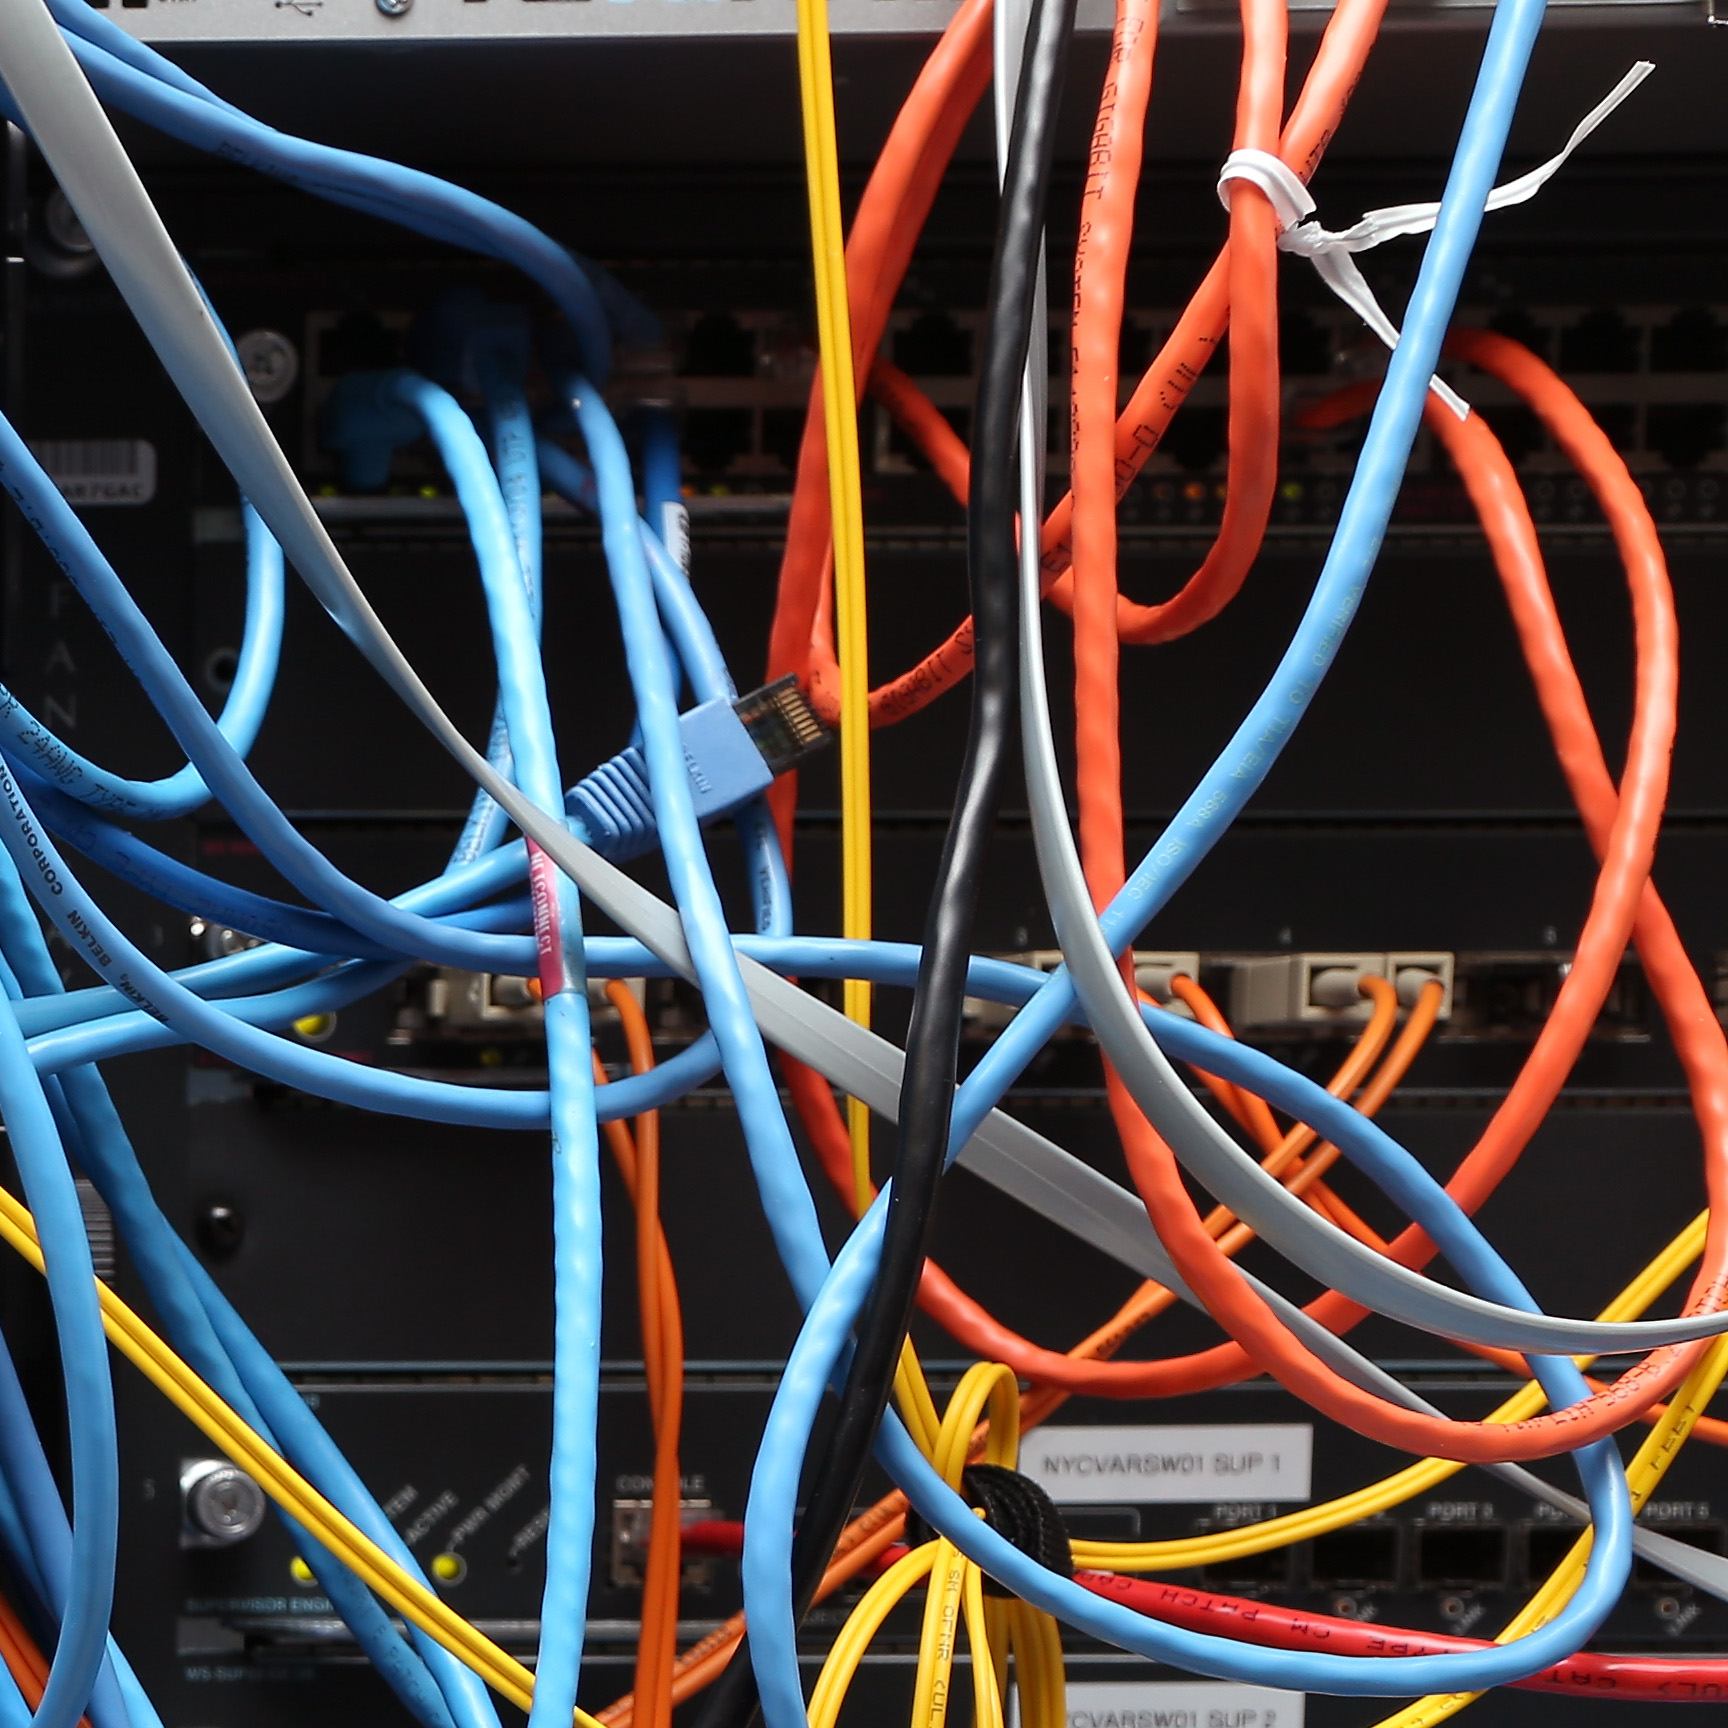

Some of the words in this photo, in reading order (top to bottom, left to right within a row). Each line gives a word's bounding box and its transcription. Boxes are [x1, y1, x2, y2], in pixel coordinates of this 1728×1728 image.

[67, 908, 113, 969] BELKIN
[1042, 1454, 1202, 1477] NYCVARSW01
[1212, 1453, 1263, 1475] SUP
[1271, 1453, 1282, 1474] 1
